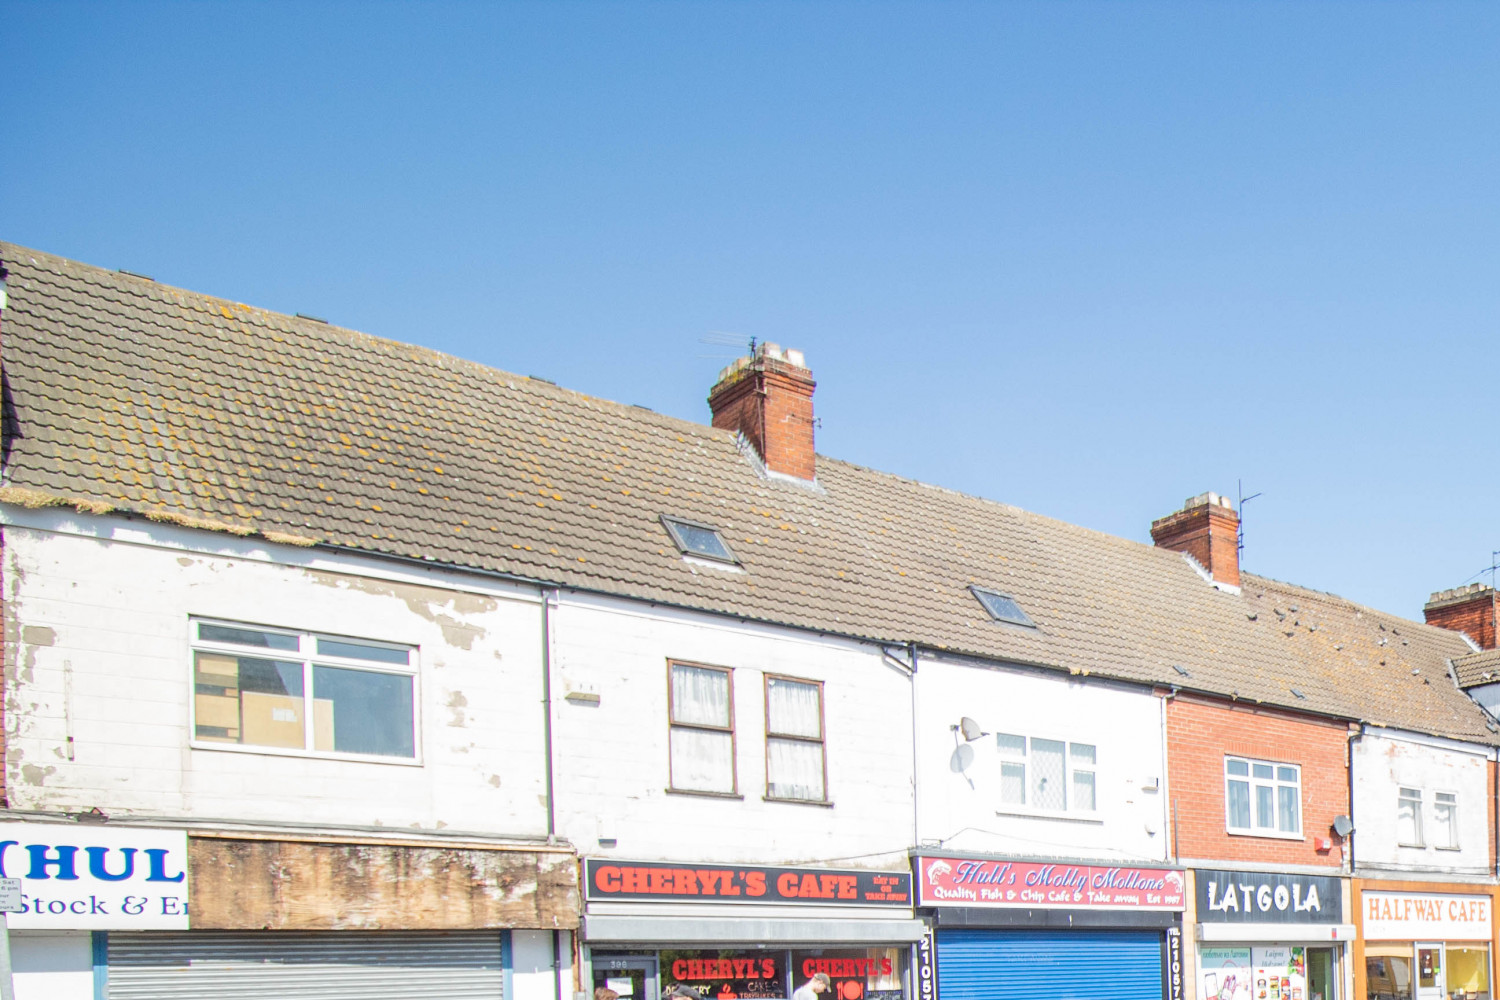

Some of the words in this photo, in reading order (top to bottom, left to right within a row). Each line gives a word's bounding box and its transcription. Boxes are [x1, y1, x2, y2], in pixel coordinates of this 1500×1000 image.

[594, 865, 767, 898] CHERYL'S
[776, 872, 858, 900] CAFE
[952, 861, 1016, 885] Hull's
[1024, 865, 1088, 893] Molly
[121, 895, 149, 915] &
[864, 892, 886, 901] TAKE
[934, 886, 977, 901] Quality
[980, 888, 1003, 900] Fish
[1006, 889, 1017, 899] &
[1020, 889, 1045, 903] Chip
[1048, 890, 1070, 902] Cafe
[1072, 890, 1083, 902] &
[1087, 891, 1111, 903] Take
[1113, 894, 1140, 906] away
[1146, 893, 1161, 904] Est
[1208, 881, 1321, 913] LATGOLA
[1368, 897, 1444, 922] HALFWAY
[1448, 900, 1487, 923] CAFE
[672, 958, 775, 980] CHERYL'S
[802, 958, 893, 978] CHERYL'S
